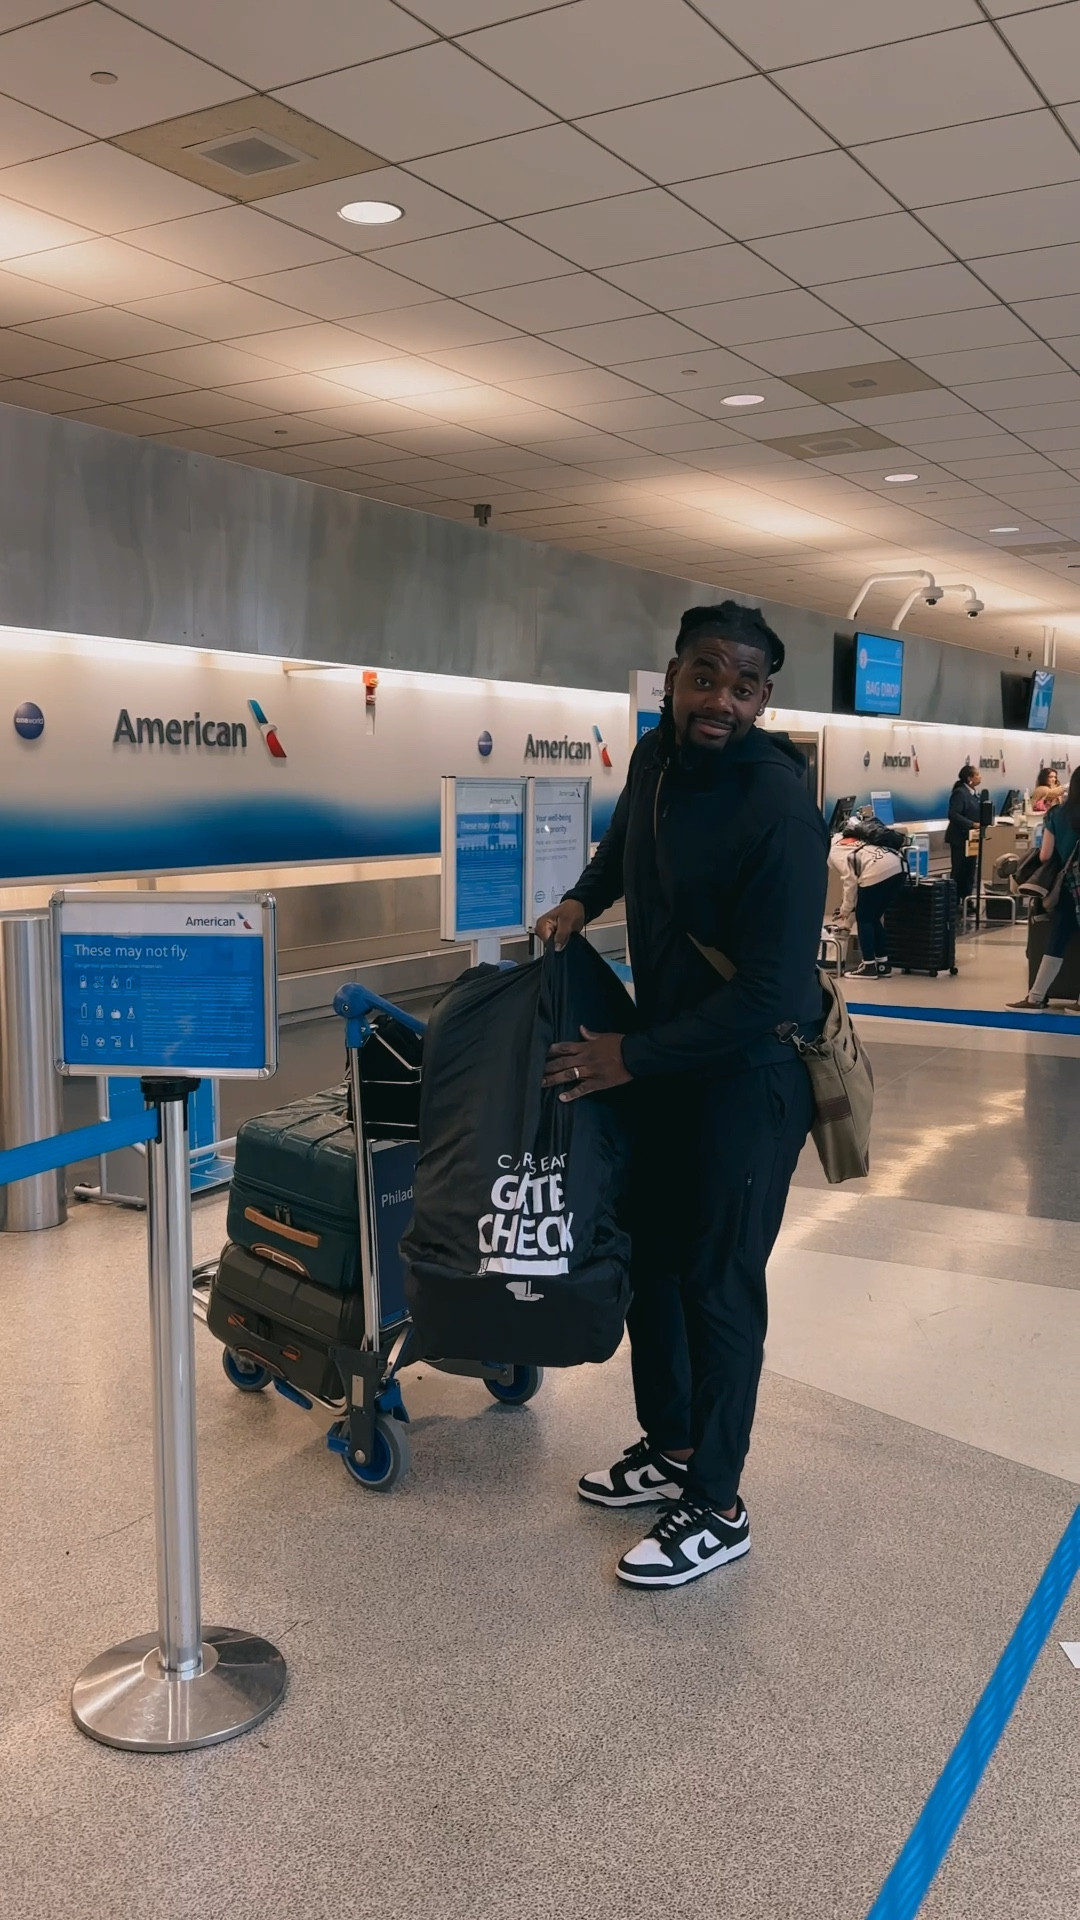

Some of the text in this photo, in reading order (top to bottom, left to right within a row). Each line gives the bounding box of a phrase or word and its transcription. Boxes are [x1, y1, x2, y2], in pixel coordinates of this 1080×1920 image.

[866, 680, 899, 697] BAG DROP
[15, 717, 44, 725] oneworld
[113, 708, 247, 747] American
[524, 733, 592, 760] American
[881, 751, 911, 767] American
[460, 821, 477, 830] These
[185, 916, 235, 927] American
[74, 944, 189, 961] These may not fly.
[381, 1185, 414, 1208] Philad
[491, 1171, 566, 1215] GATE
[477, 1212, 575, 1256] CHECK
